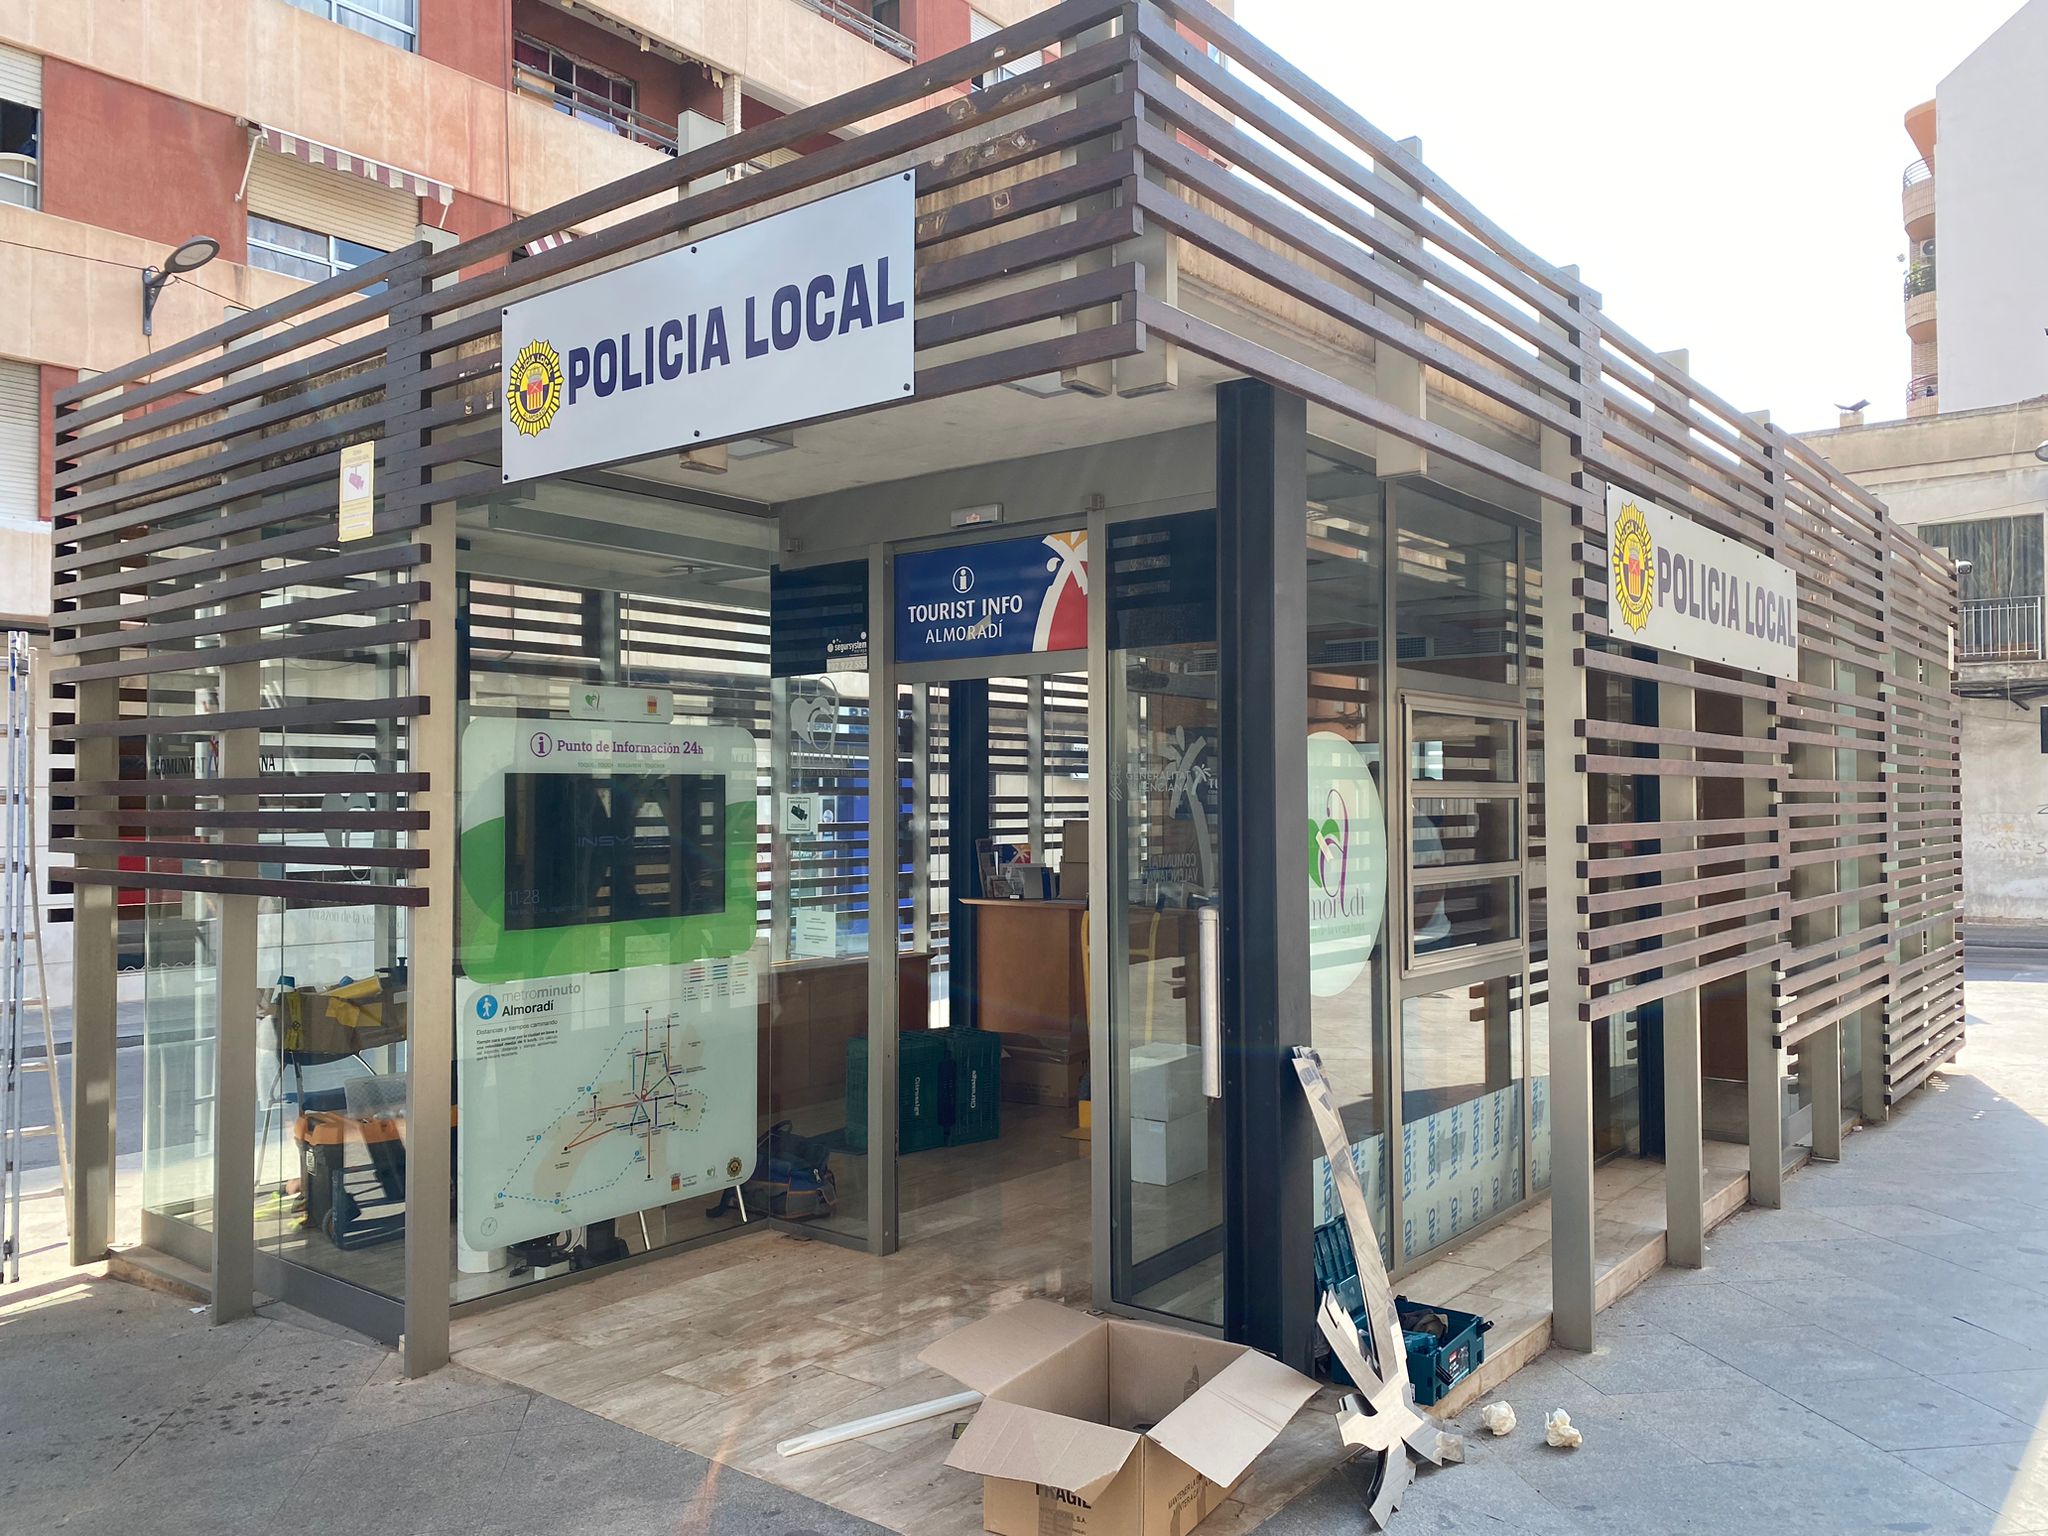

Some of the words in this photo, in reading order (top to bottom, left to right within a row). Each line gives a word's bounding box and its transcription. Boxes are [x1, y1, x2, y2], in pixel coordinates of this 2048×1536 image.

[568, 306, 731, 405] POLICIA
[745, 256, 905, 360] LOCAL
[908, 600, 975, 623] TOURIST
[982, 595, 1023, 617] INFO
[1657, 546, 1740, 631] POLICIA
[1745, 581, 1796, 649] LOCAL
[925, 619, 1003, 644] ALMORADÍ
[557, 739, 592, 752] Punto
[596, 740, 610, 752] de
[612, 740, 680, 754] Información
[683, 741, 704, 755] 24h
[502, 983, 581, 1003] metrominuto
[501, 999, 554, 1017] Almoradí
